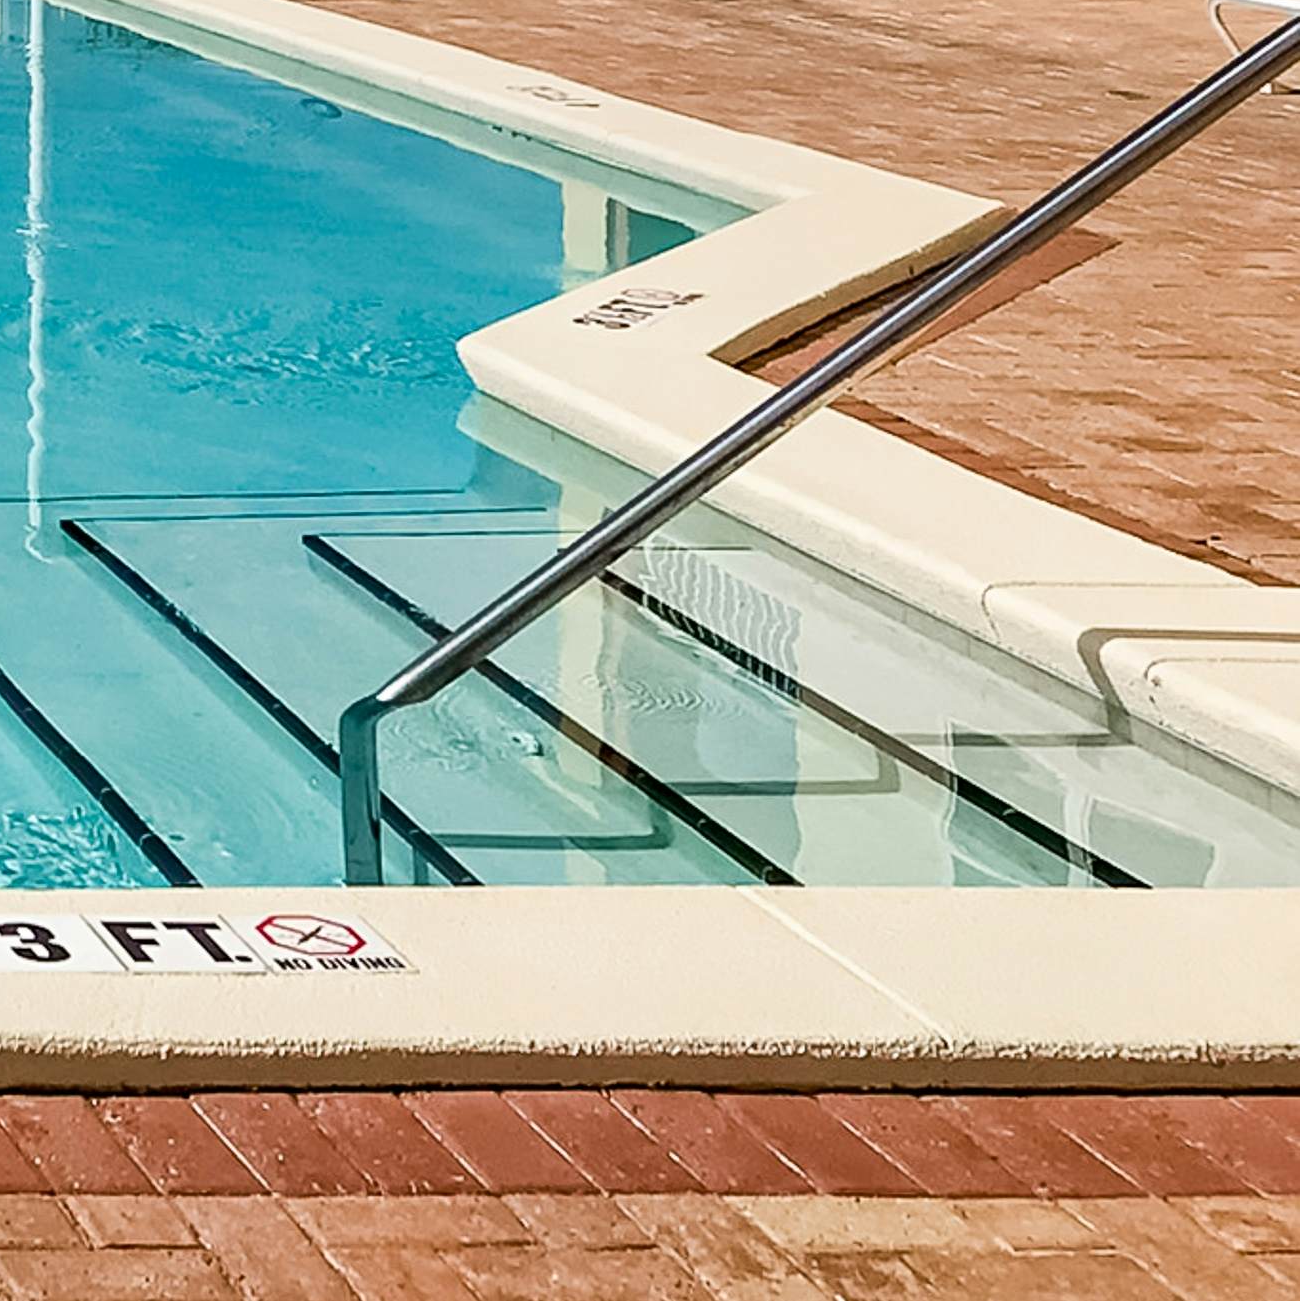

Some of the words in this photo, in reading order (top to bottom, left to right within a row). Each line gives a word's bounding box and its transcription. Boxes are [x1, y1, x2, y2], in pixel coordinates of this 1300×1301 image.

[101, 921, 253, 962] FT.
[274, 957, 313, 971] NO
[316, 957, 406, 970] DIVING
